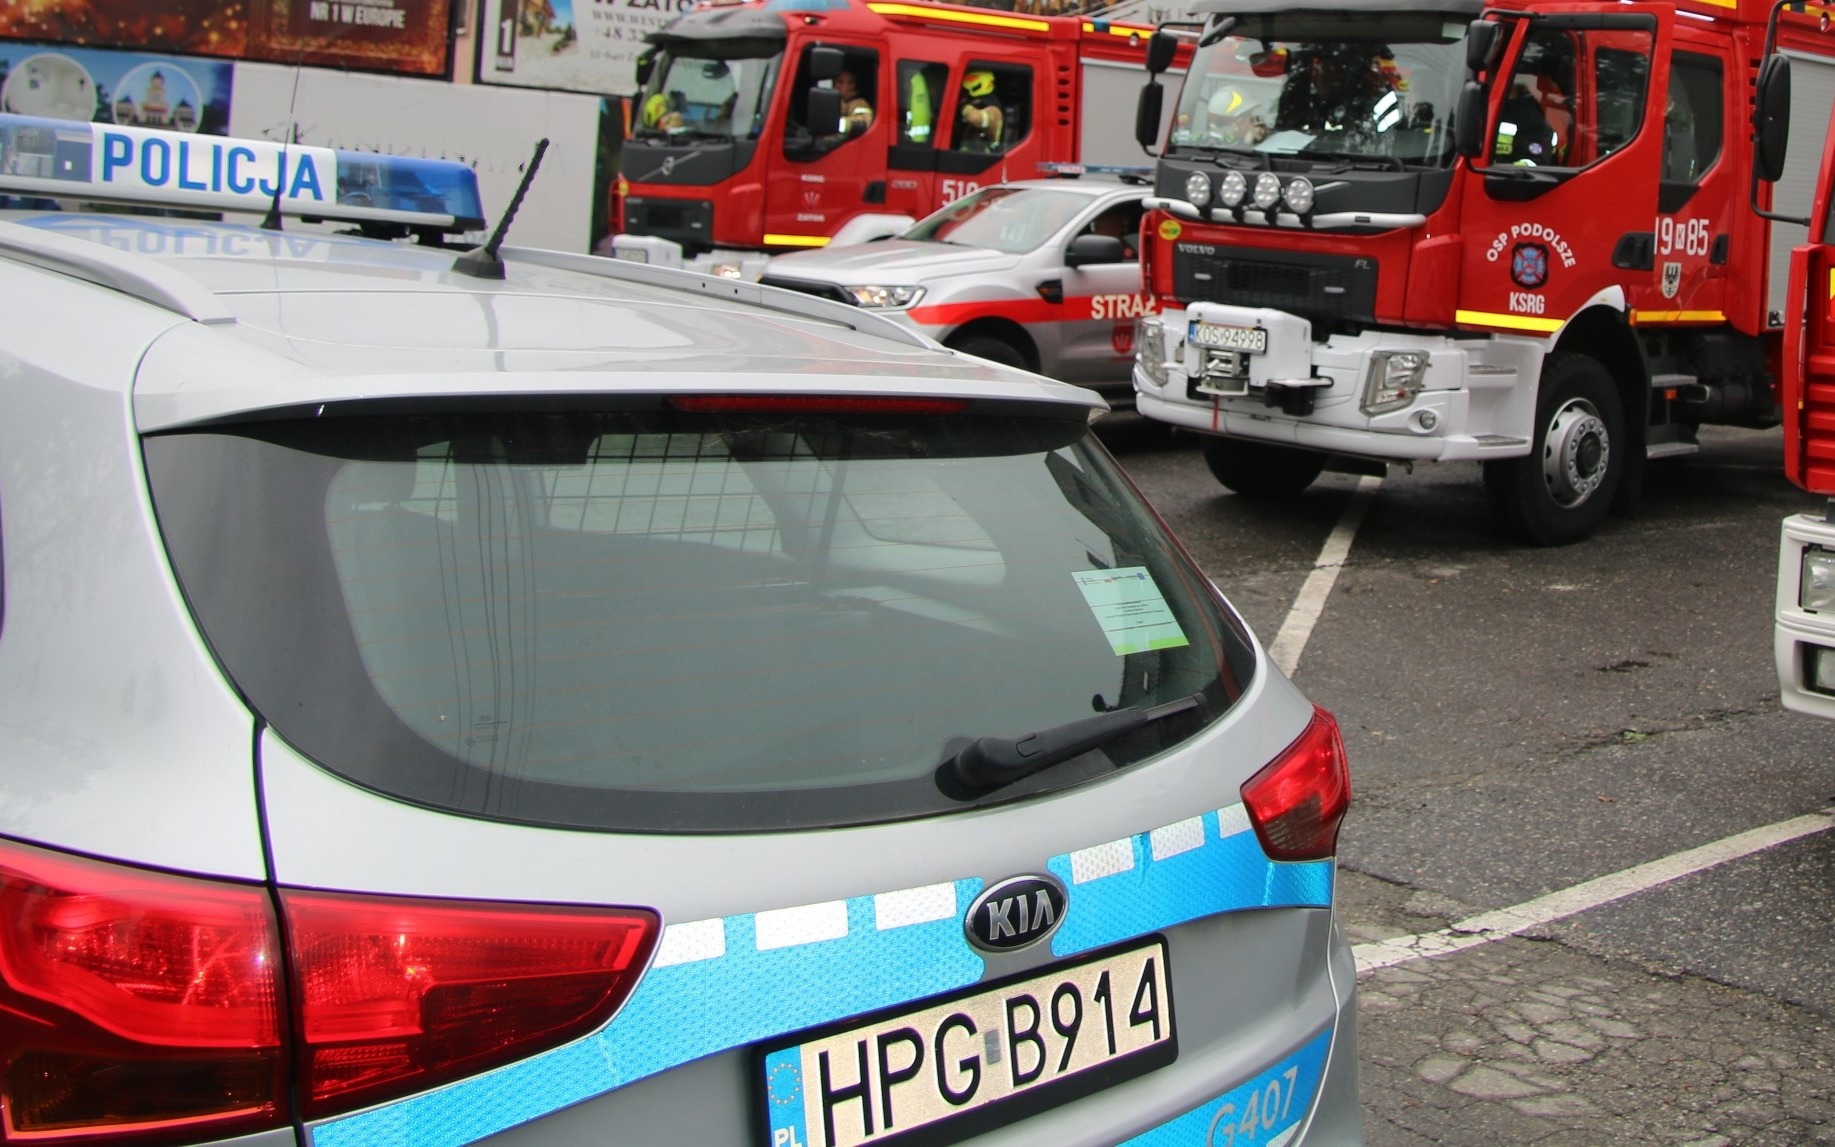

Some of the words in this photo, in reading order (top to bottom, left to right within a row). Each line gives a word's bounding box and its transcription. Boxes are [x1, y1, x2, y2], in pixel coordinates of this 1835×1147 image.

[102, 132, 323, 201] POLICJA
[1177, 243, 1216, 256] VOLVO
[1355, 259, 1370, 270] FL
[1486, 232, 1508, 262] OSP
[1511, 222, 1576, 268] PODOLSZE
[1509, 291, 1545, 314] KSRG
[987, 889, 1054, 941] KIA
[817, 1011, 982, 1147] HPG
[1006, 957, 1161, 1088] B914
[1206, 1065, 1298, 1147] G407
[774, 1125, 803, 1147] PL
